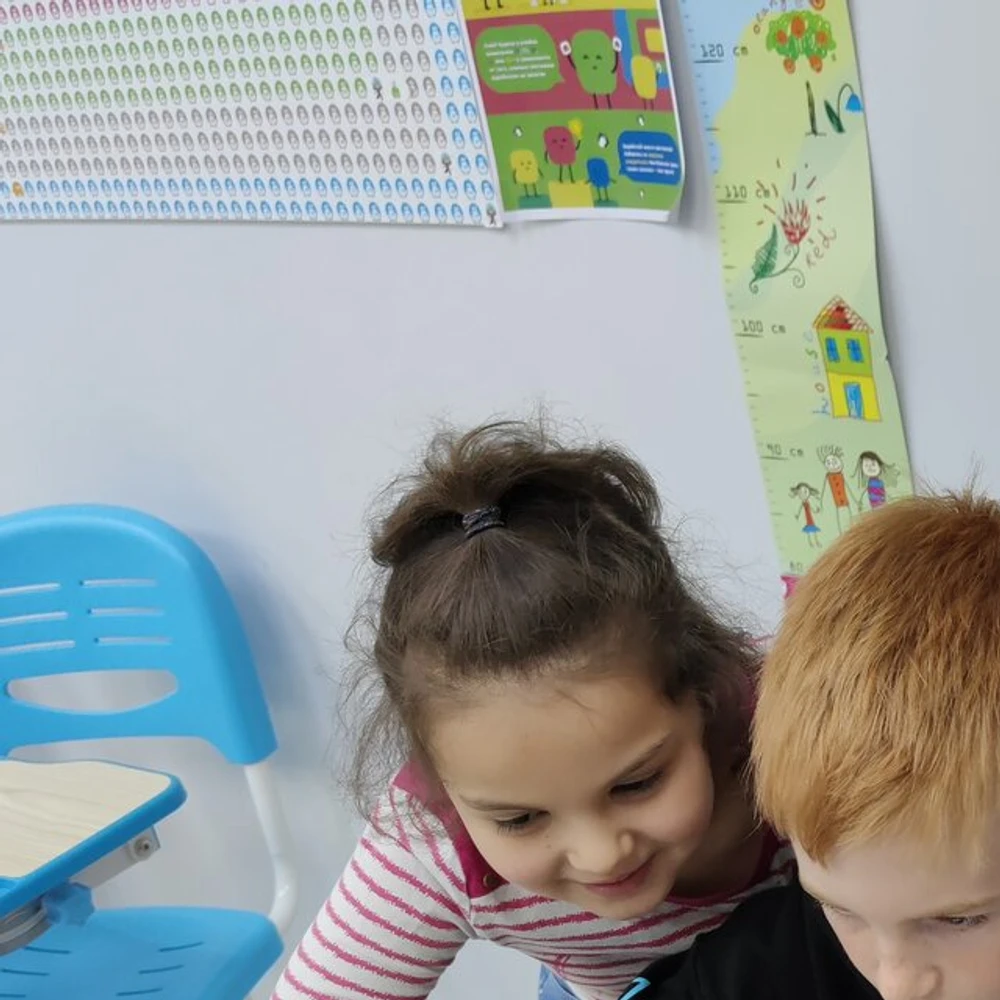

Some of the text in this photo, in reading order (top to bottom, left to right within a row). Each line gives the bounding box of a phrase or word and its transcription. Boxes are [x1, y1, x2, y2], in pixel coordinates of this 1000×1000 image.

[700, 43, 725, 57] 120
[725, 185, 748, 199] 110
[806, 228, 838, 268] red
[741, 320, 764, 333] 100
